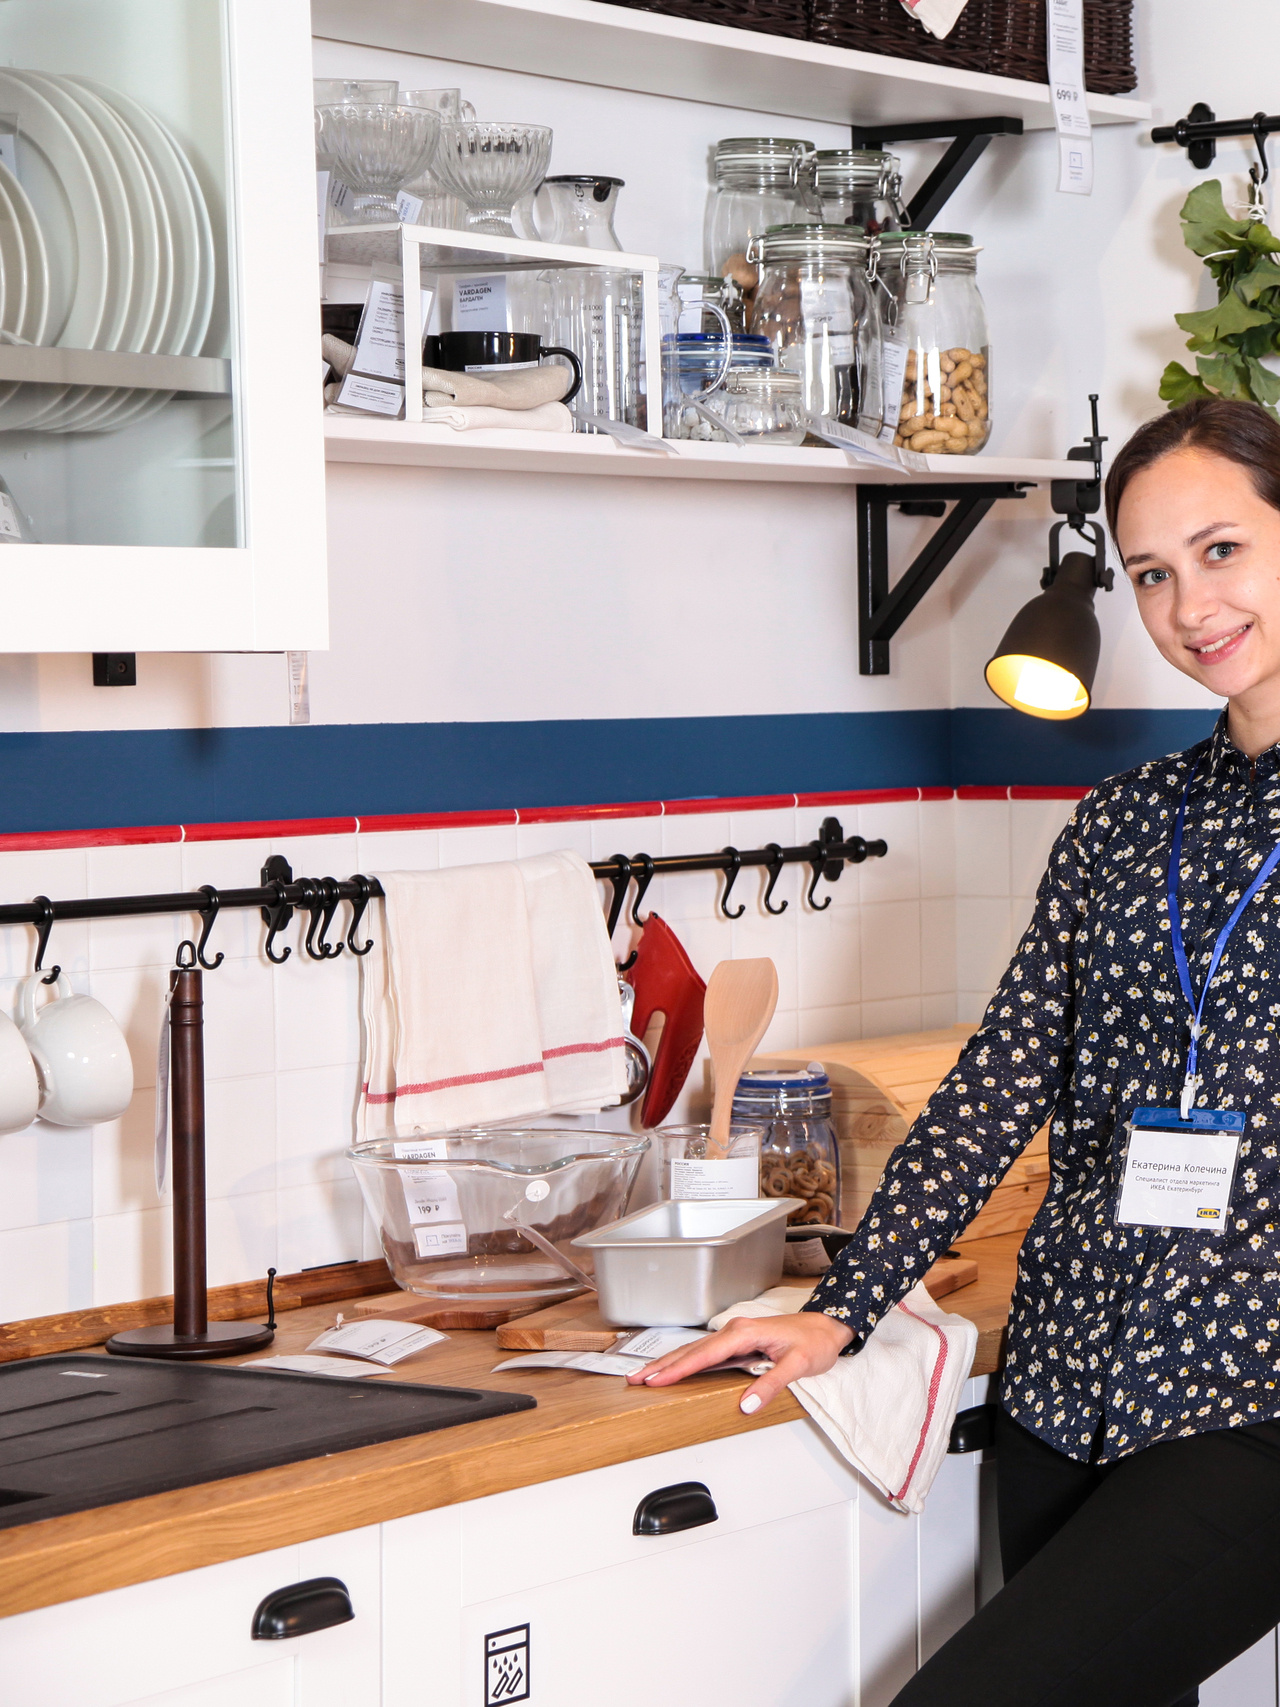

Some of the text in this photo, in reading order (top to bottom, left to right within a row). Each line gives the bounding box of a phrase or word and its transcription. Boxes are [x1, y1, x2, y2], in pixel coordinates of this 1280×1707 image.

[1056, 88, 1072, 101] 699
[459, 287, 492, 296] VARDAGEN
[1132, 1160, 1228, 1174] Екатерина Колечина
[1135, 1175, 1168, 1184] Специалист
[418, 1205, 432, 1214] 199
